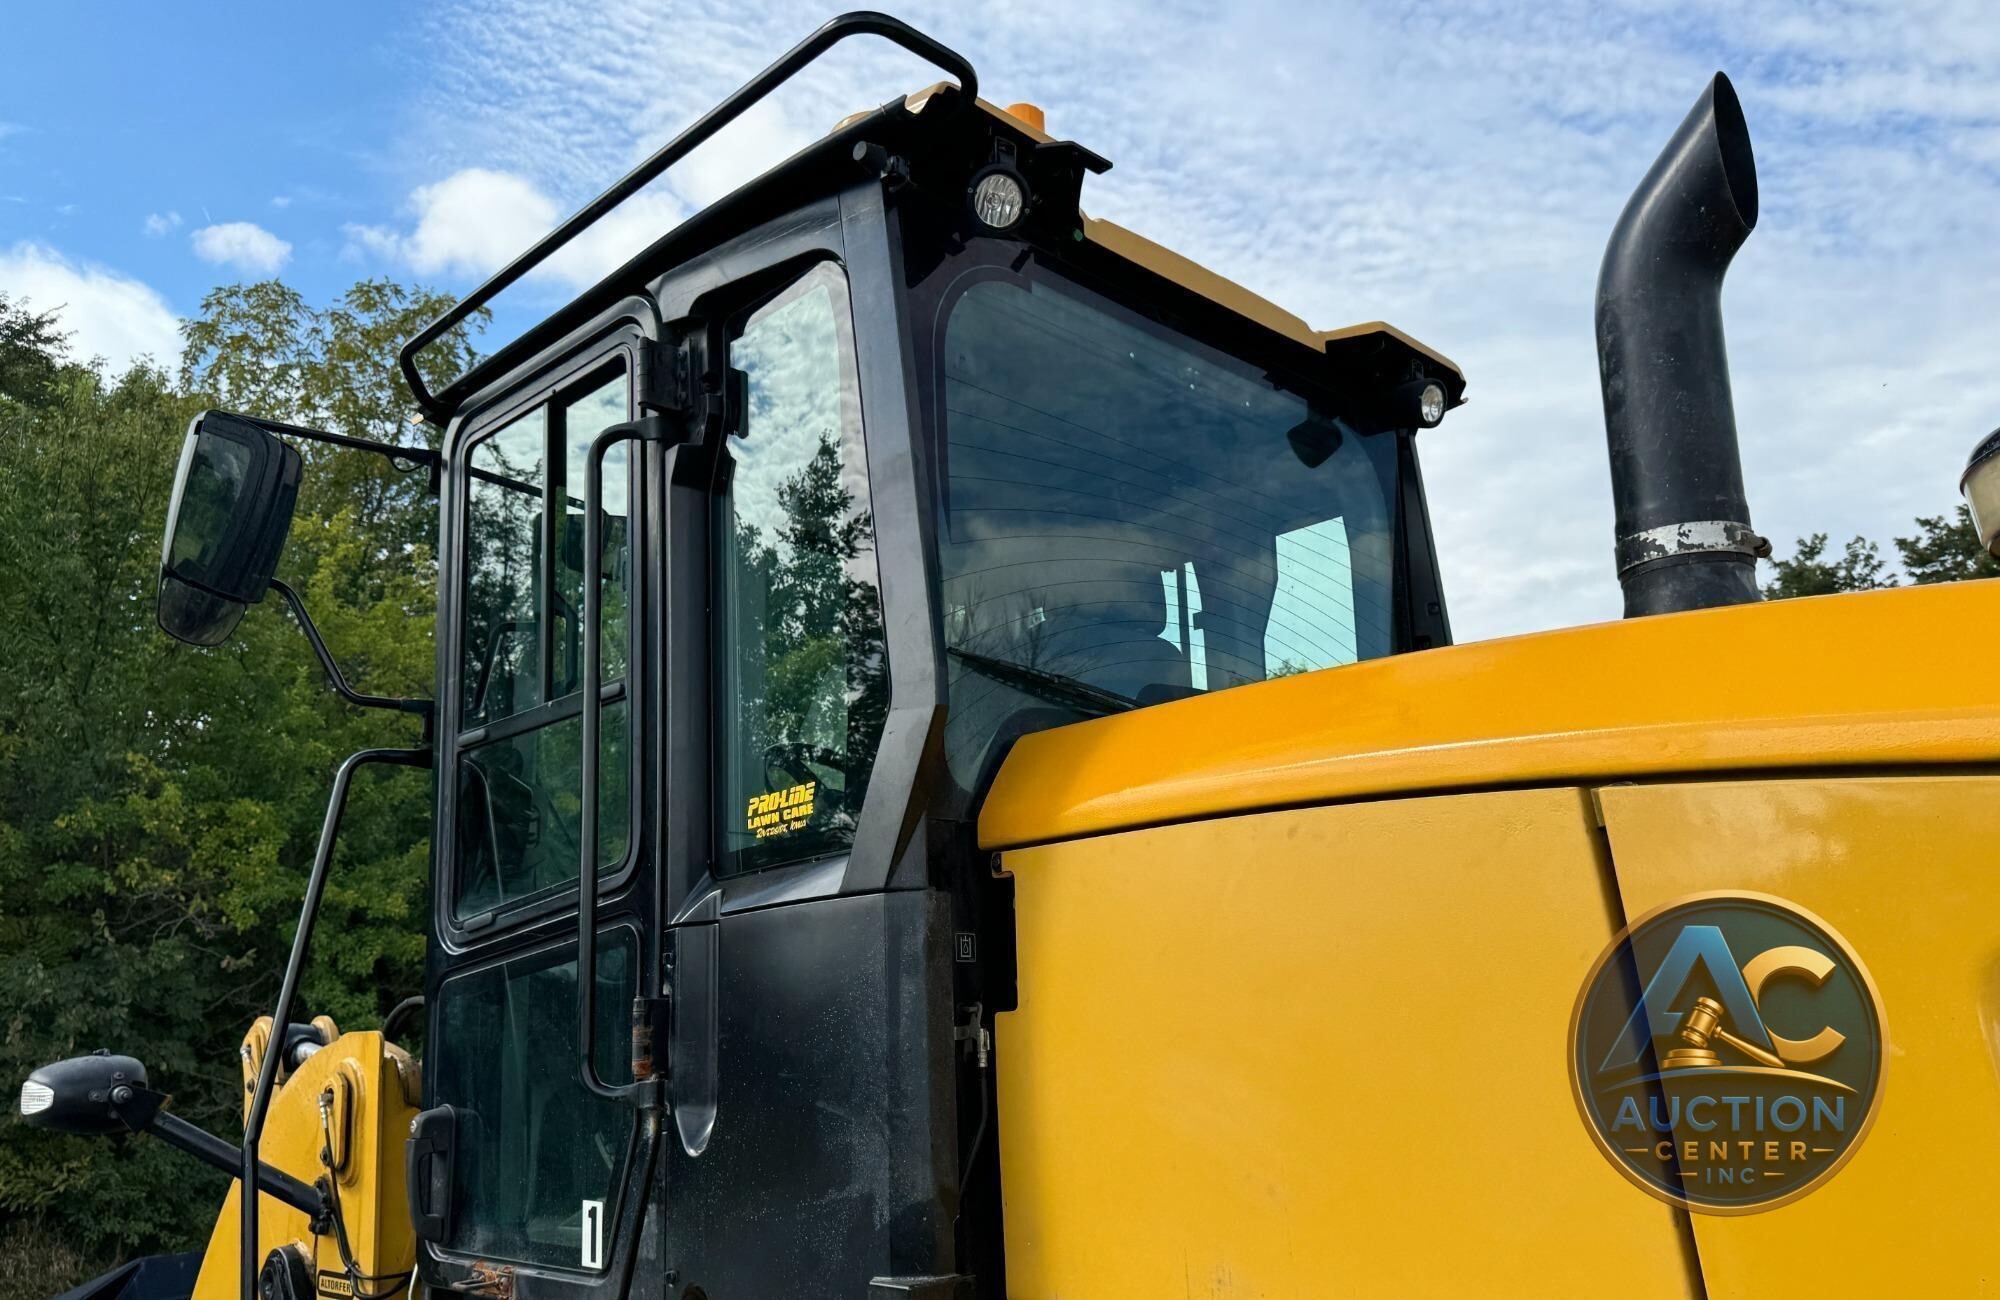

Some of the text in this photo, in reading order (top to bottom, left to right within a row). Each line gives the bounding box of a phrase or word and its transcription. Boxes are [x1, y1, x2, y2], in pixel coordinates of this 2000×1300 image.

[747, 803, 814, 829] LAWN CARE
[588, 1206, 597, 1263] 1
[320, 1278, 351, 1293] ALTORFER
